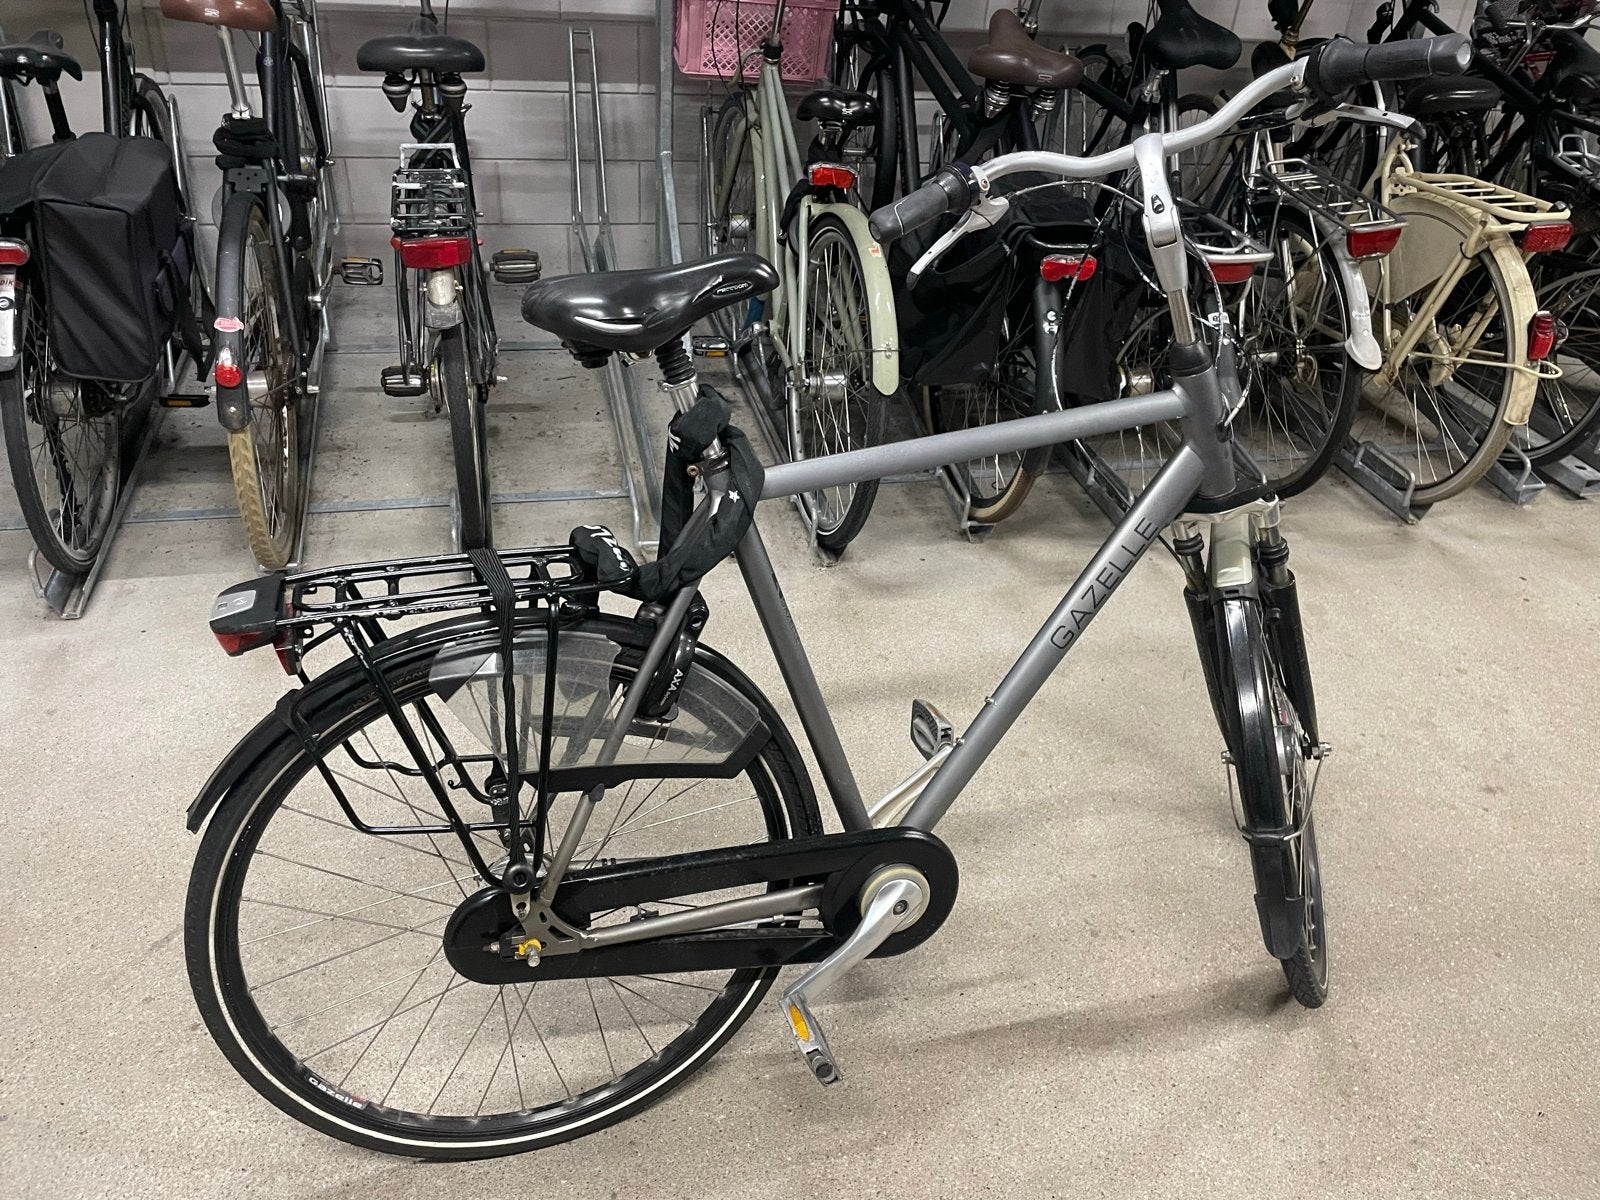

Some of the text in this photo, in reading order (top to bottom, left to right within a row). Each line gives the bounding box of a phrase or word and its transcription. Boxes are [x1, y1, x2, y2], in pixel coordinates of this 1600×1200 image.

[1050, 516, 1159, 650] GAZELLE
[667, 668, 684, 691] AXA
[308, 1076, 363, 1109] Gazelle
